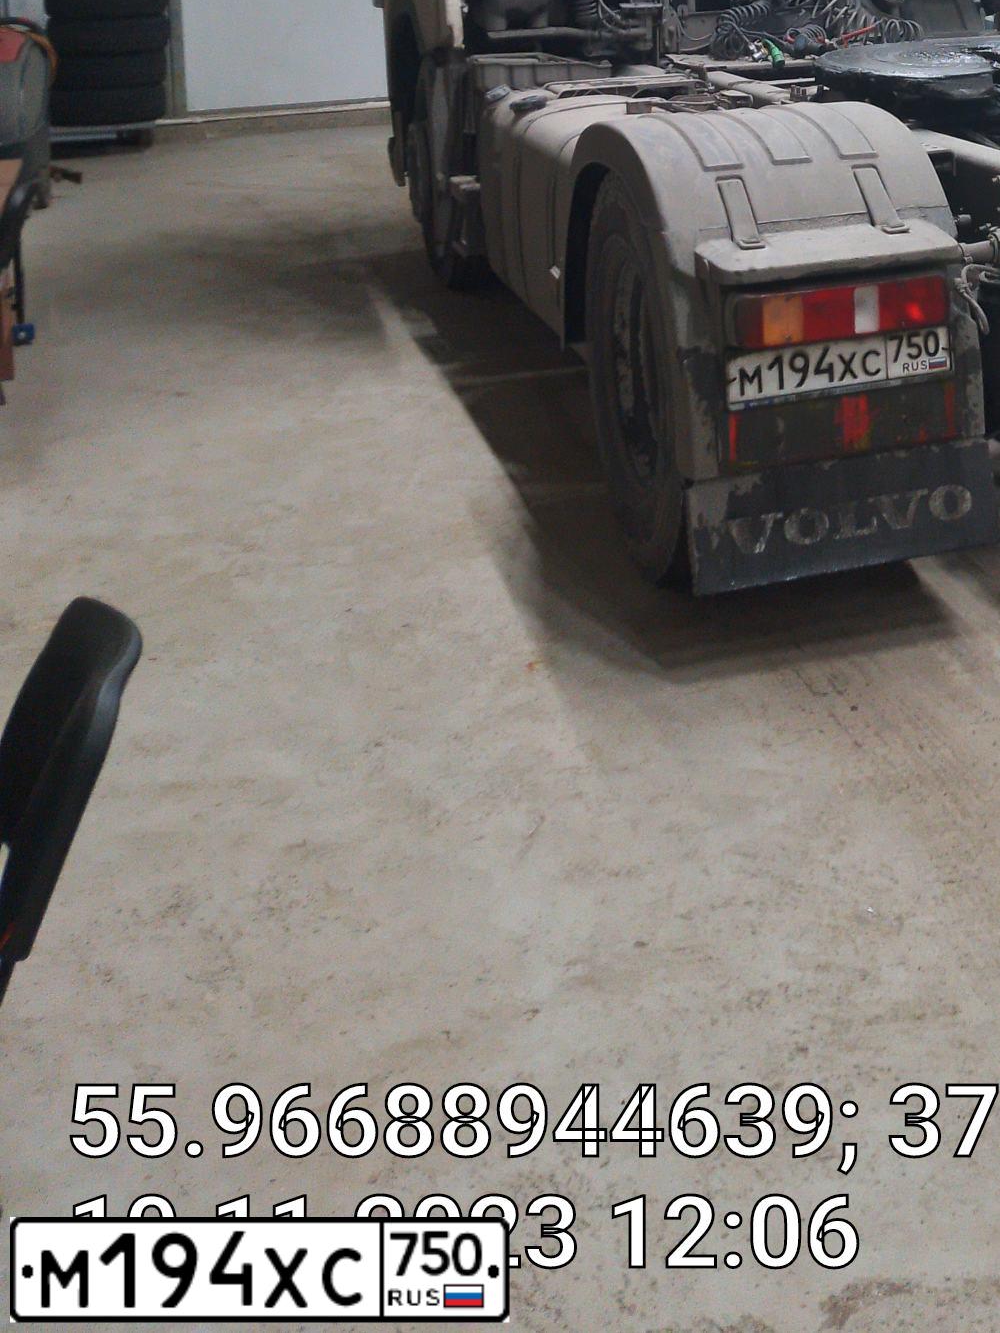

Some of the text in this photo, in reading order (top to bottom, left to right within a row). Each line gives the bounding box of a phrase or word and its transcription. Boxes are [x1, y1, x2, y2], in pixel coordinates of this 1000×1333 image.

[888, 330, 939, 364] 750
[902, 358, 928, 373] RUS
[727, 483, 972, 554] VOLVO
